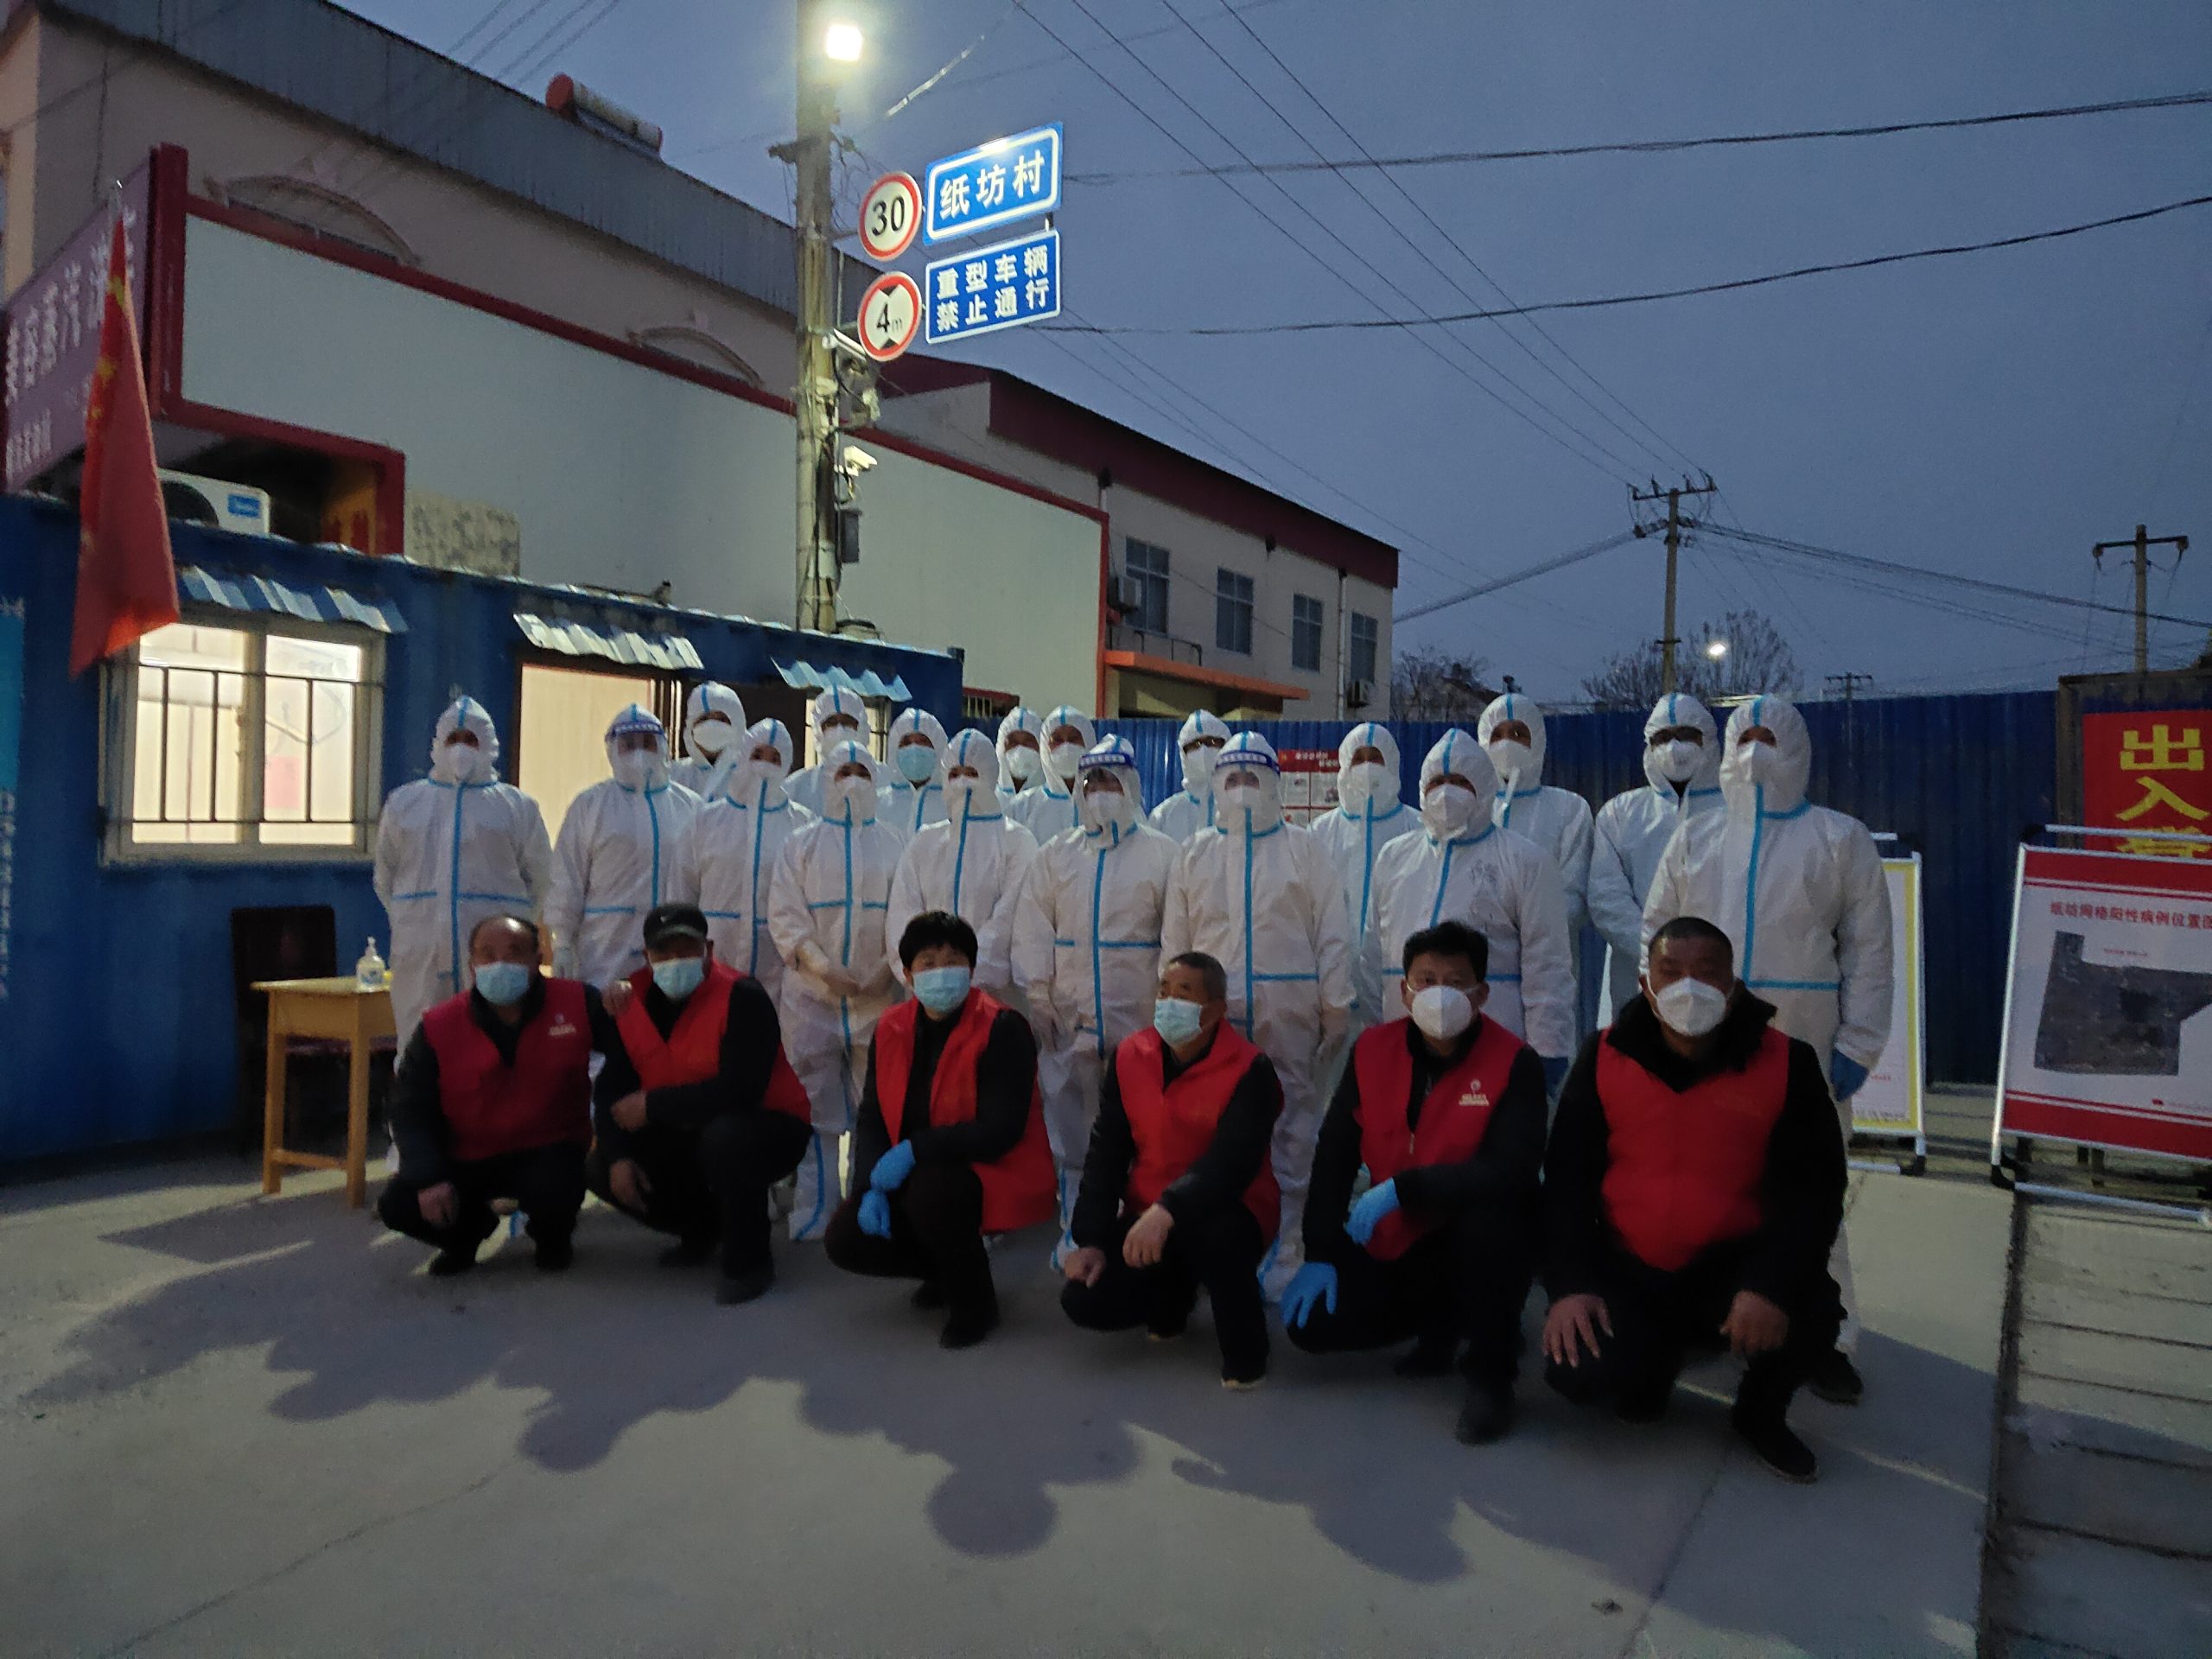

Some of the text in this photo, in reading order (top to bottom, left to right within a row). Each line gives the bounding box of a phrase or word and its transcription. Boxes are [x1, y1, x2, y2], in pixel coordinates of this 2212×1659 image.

[938, 149, 1046, 219] 纸坊村
[871, 196, 906, 237] 30
[937, 245, 1048, 301] 重型车辆
[876, 302, 904, 334] 4m
[937, 278, 1050, 332] 禁止通行
